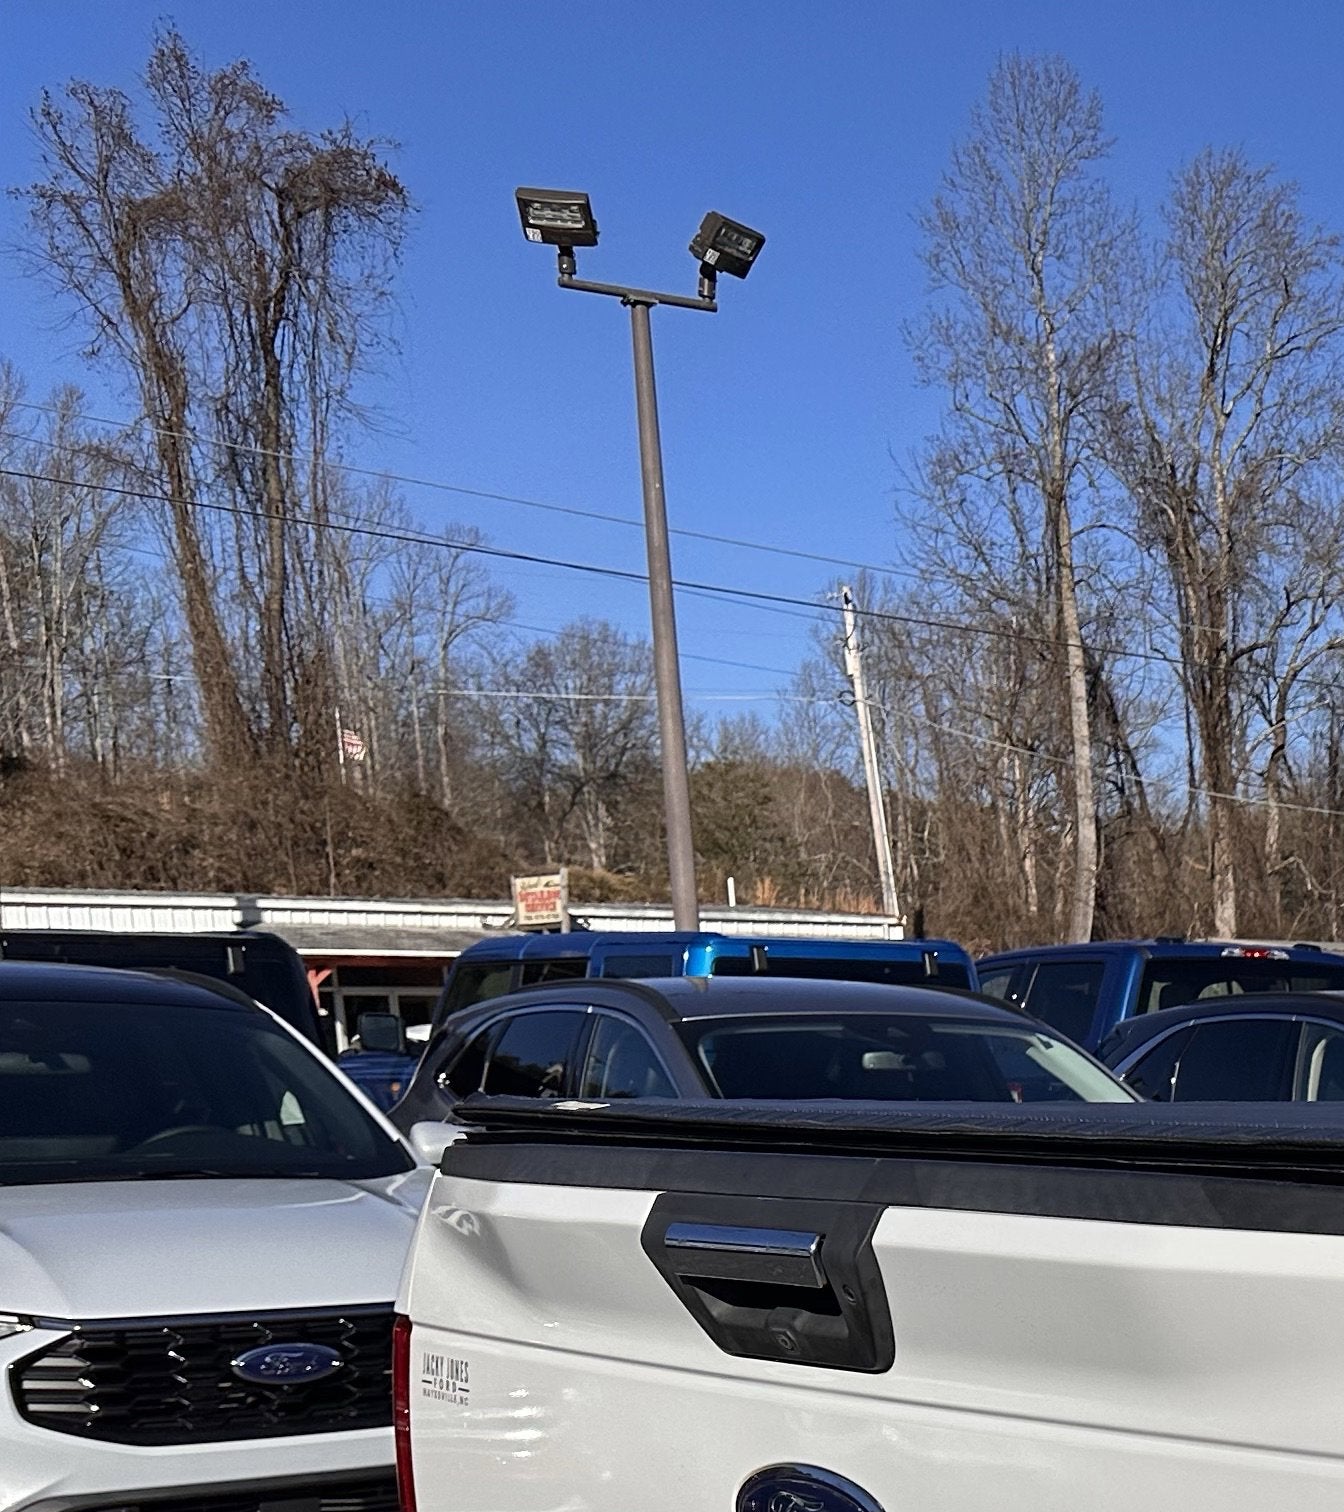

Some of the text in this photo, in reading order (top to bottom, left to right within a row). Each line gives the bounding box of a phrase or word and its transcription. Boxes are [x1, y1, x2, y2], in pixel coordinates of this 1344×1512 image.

[422, 1352, 469, 1384] JACKY JONES
[433, 1377, 457, 1393] FORD
